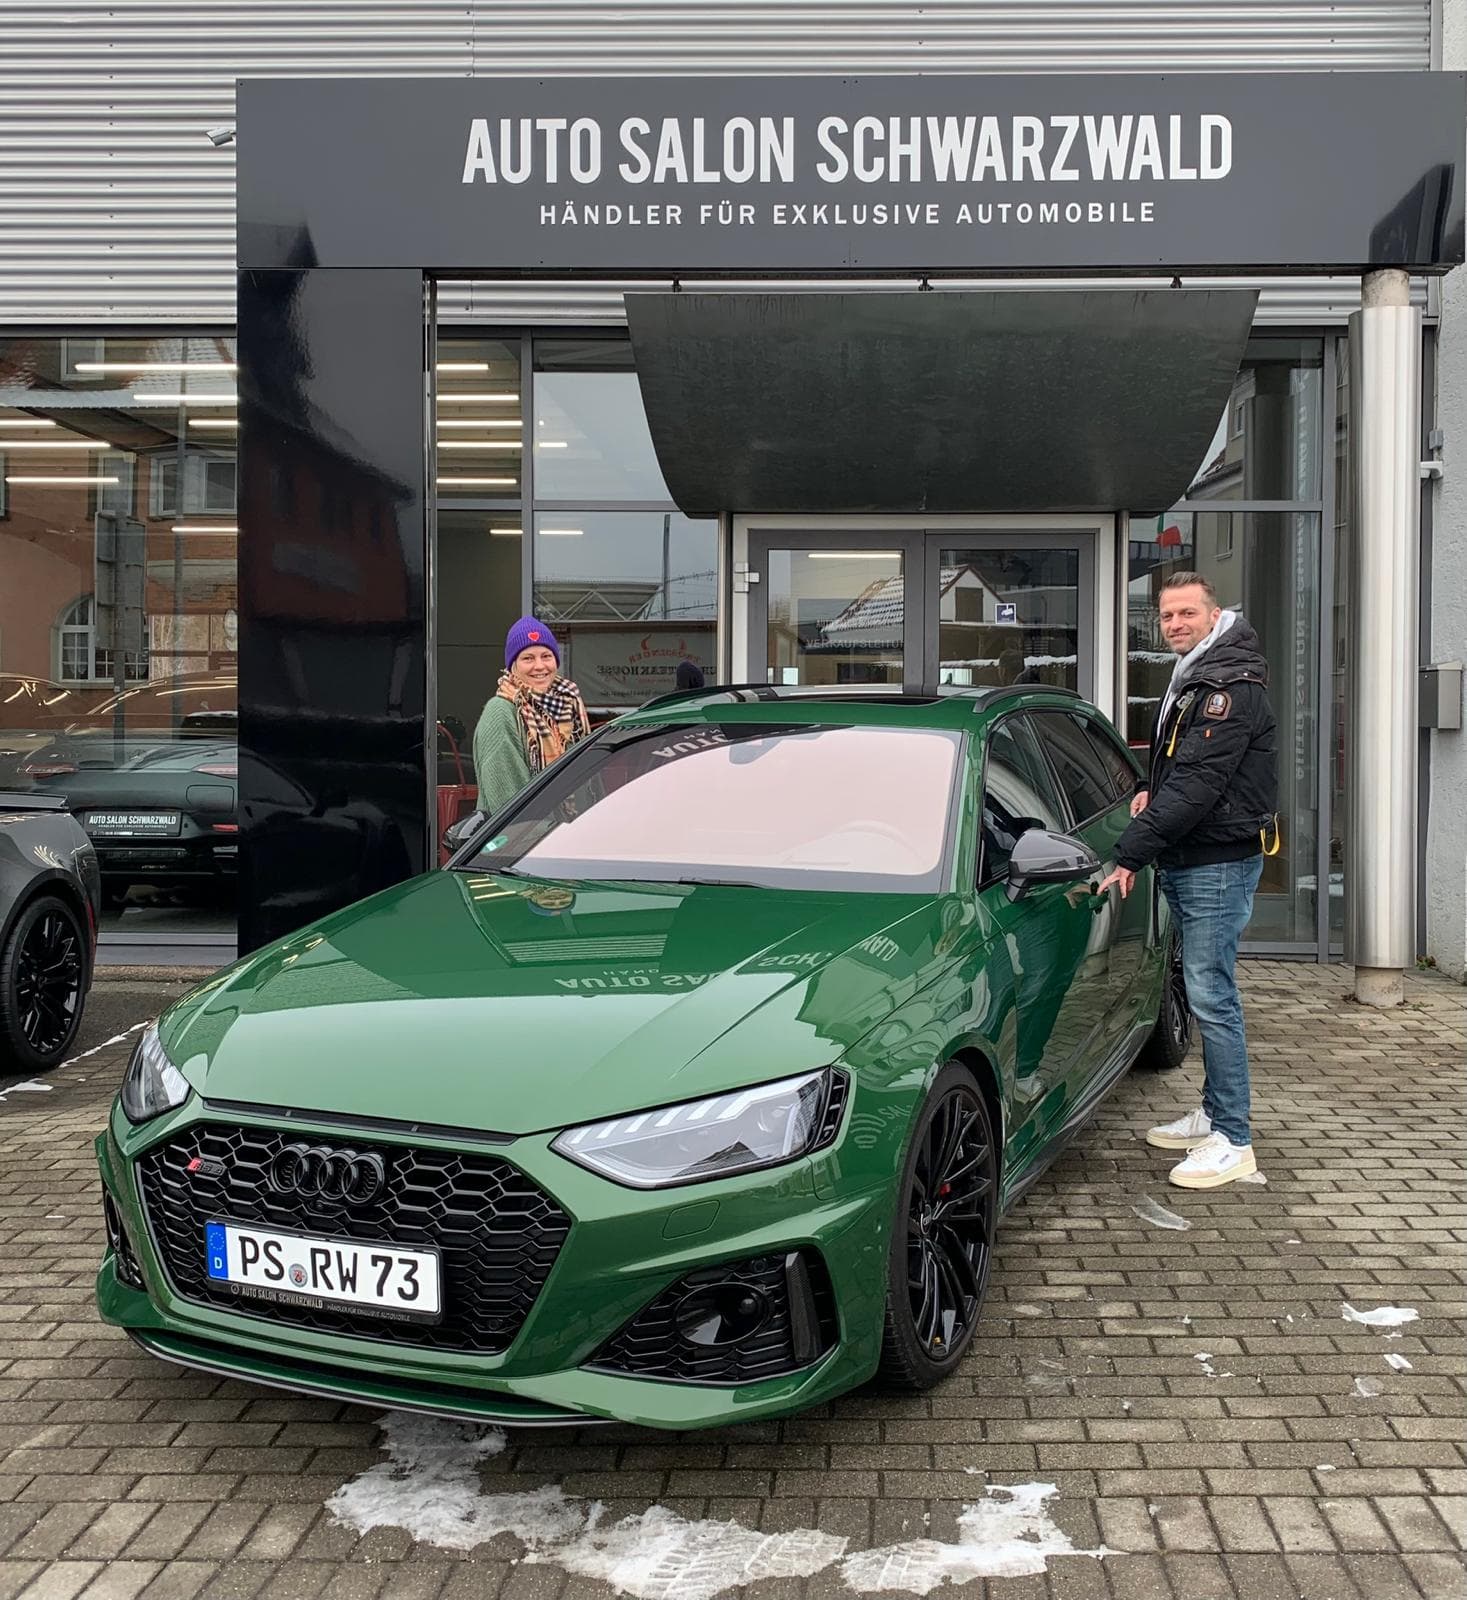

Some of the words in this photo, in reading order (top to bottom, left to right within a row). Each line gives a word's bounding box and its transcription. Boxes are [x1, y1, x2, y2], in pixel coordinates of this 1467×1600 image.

[462, 117, 602, 184] AUTO
[618, 116, 795, 184] SALON
[816, 114, 1233, 183] SCHWARZWALD
[540, 201, 682, 226] HÄNDLER
[700, 200, 756, 225] FÜR
[773, 202, 940, 225] EXKLUSIVE
[956, 201, 1155, 224] AUTOMOBILE
[88, 815, 106, 825] AUTO
[106, 815, 127, 825] SALON
[128, 815, 177, 825] SCHWARZWALD
[213, 1256, 223, 1269] D
[238, 1235, 285, 1281] PS
[310, 1248, 359, 1293] RW
[371, 1254, 419, 1302] 73
[242, 1287, 257, 1298] AUTO
[257, 1289, 277, 1302] SALON
[279, 1293, 323, 1309] SCHWARZWALD
